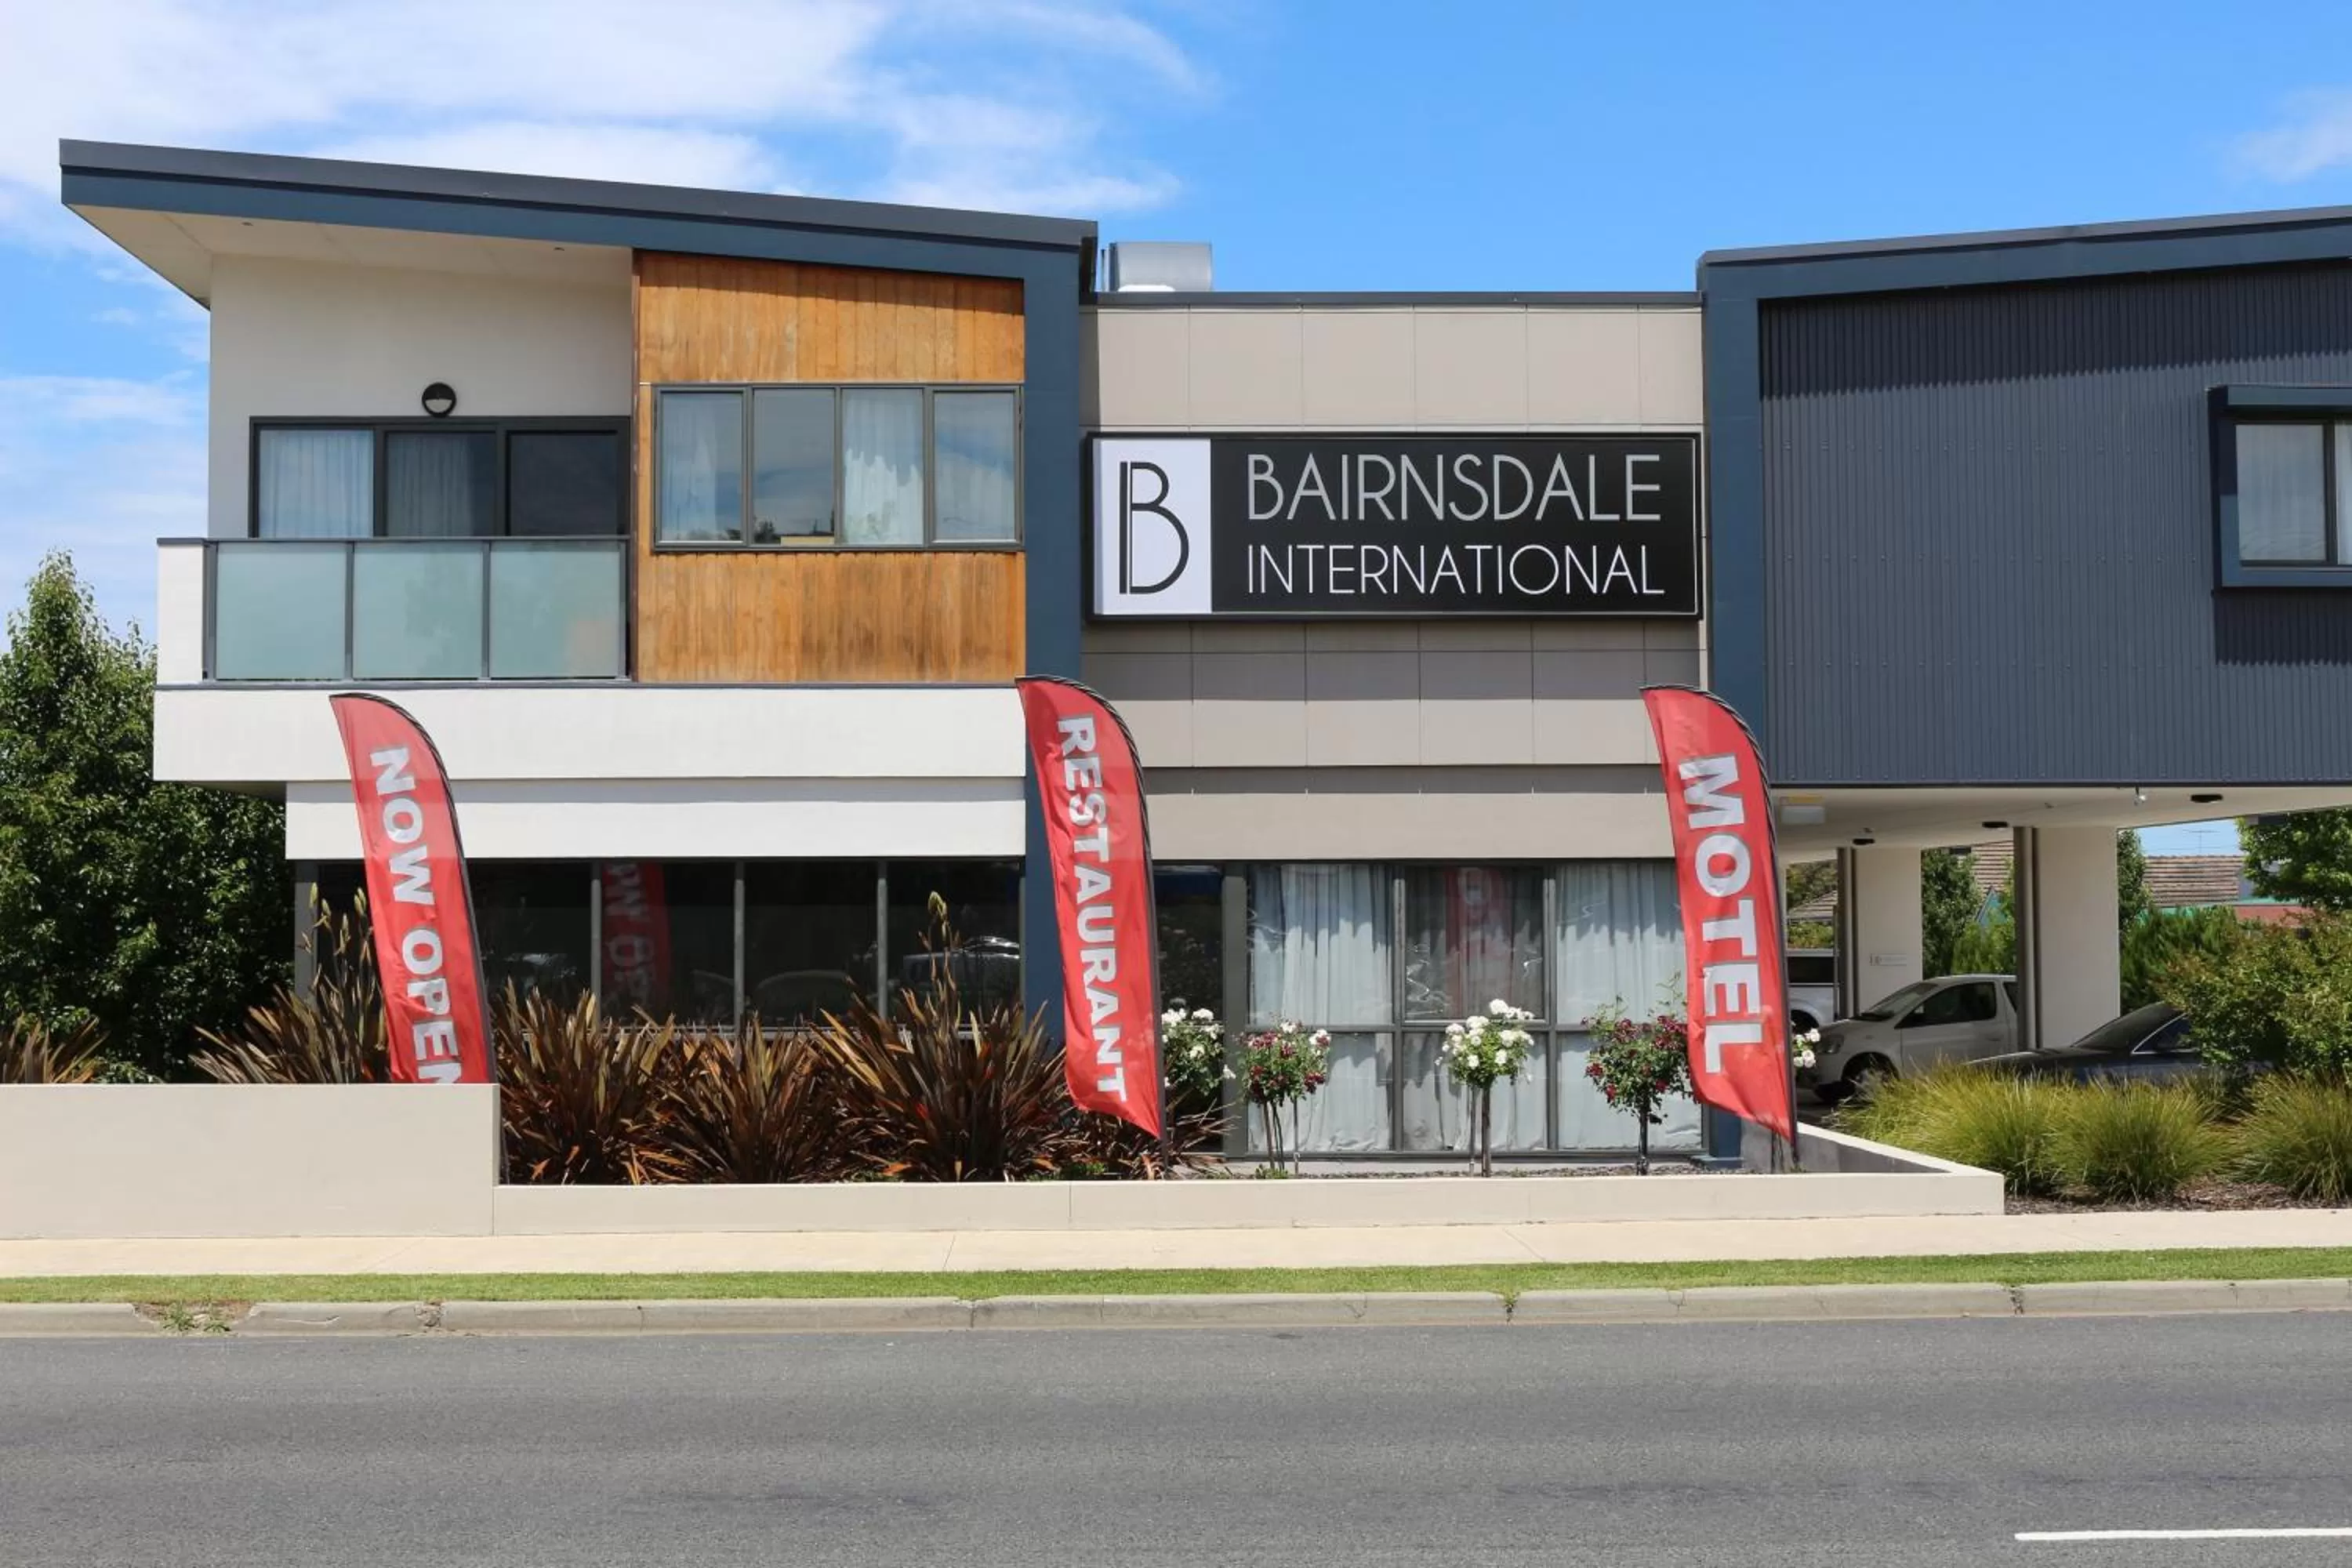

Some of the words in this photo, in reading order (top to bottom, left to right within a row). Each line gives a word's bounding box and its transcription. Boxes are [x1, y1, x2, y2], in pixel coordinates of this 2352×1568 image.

[1120, 461, 1189, 594] B
[1247, 452, 1661, 521] BAIRNSDALE
[1248, 544, 1665, 594] INTERNATIONAL
[370, 746, 434, 906] NOW
[1058, 714, 1127, 1102] RESTAURANT
[1678, 755, 1762, 1074] MOTEL
